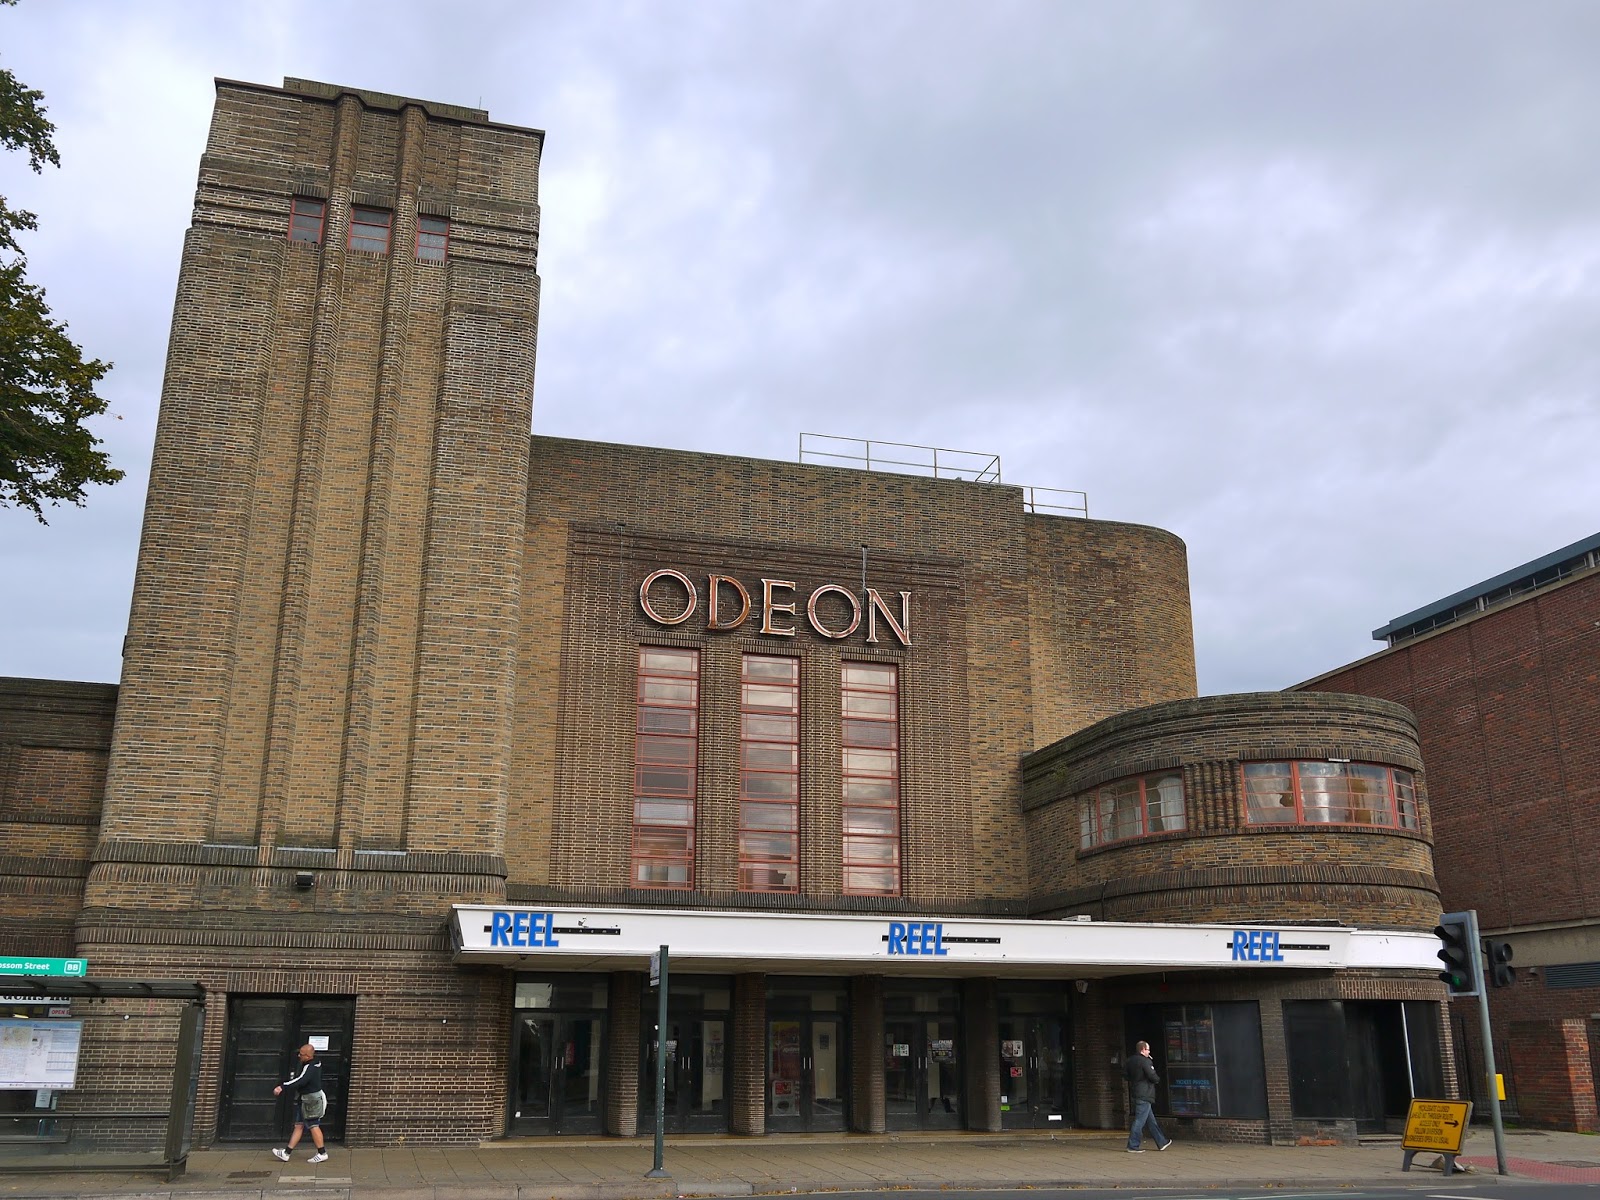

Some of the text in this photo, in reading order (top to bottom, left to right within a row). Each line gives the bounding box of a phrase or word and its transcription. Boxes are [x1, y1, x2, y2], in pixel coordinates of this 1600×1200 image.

[639, 568, 912, 646] ODEON
[490, 911, 559, 947] REEL
[887, 919, 948, 956] REEL
[1231, 930, 1285, 962] REEL
[24, 962, 50, 970] Street
